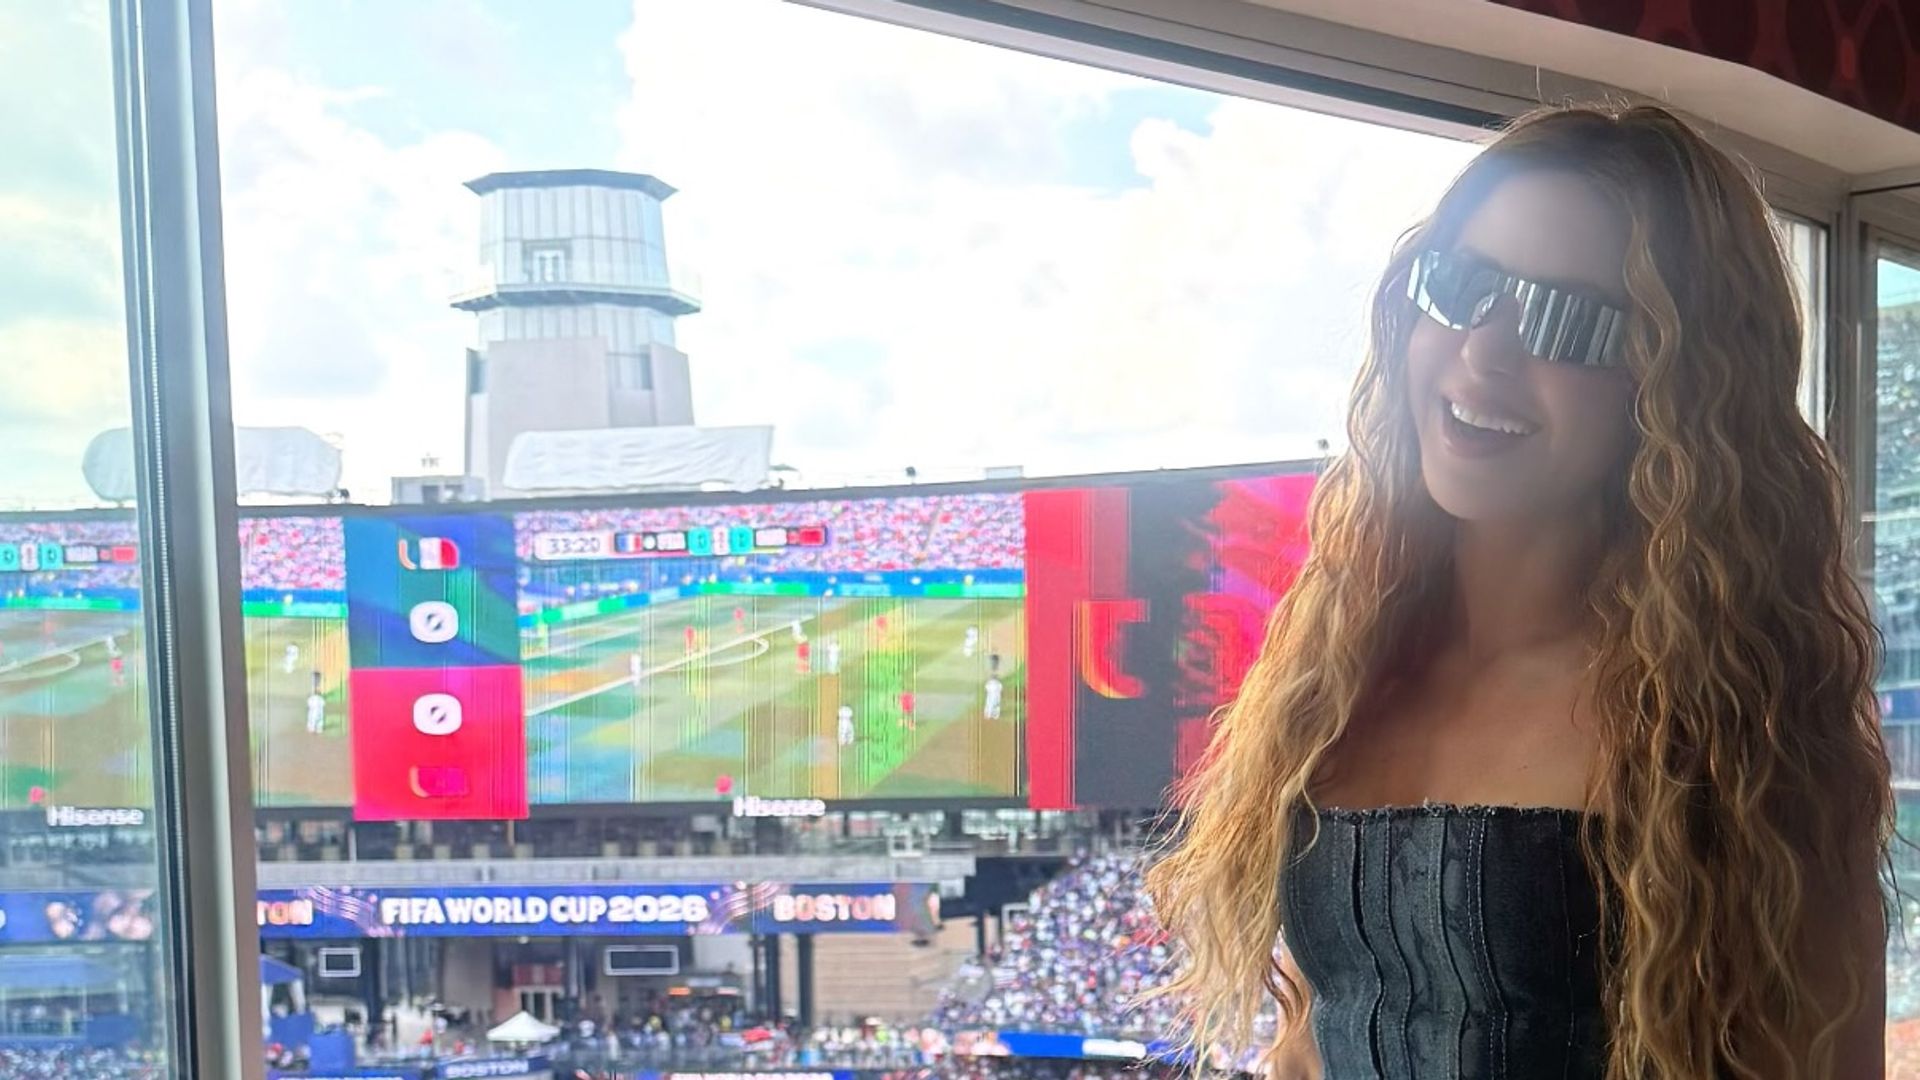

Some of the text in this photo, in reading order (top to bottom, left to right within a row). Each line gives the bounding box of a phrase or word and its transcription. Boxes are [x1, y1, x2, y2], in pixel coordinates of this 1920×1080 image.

[546, 537, 601, 554] 33:20
[46, 806, 144, 826] Hisense
[733, 796, 825, 816] Hisense
[382, 894, 708, 924] FIFA WORLD CUP 2026
[773, 893, 896, 921] BOSTON
[445, 1059, 529, 1078] BOSTON
